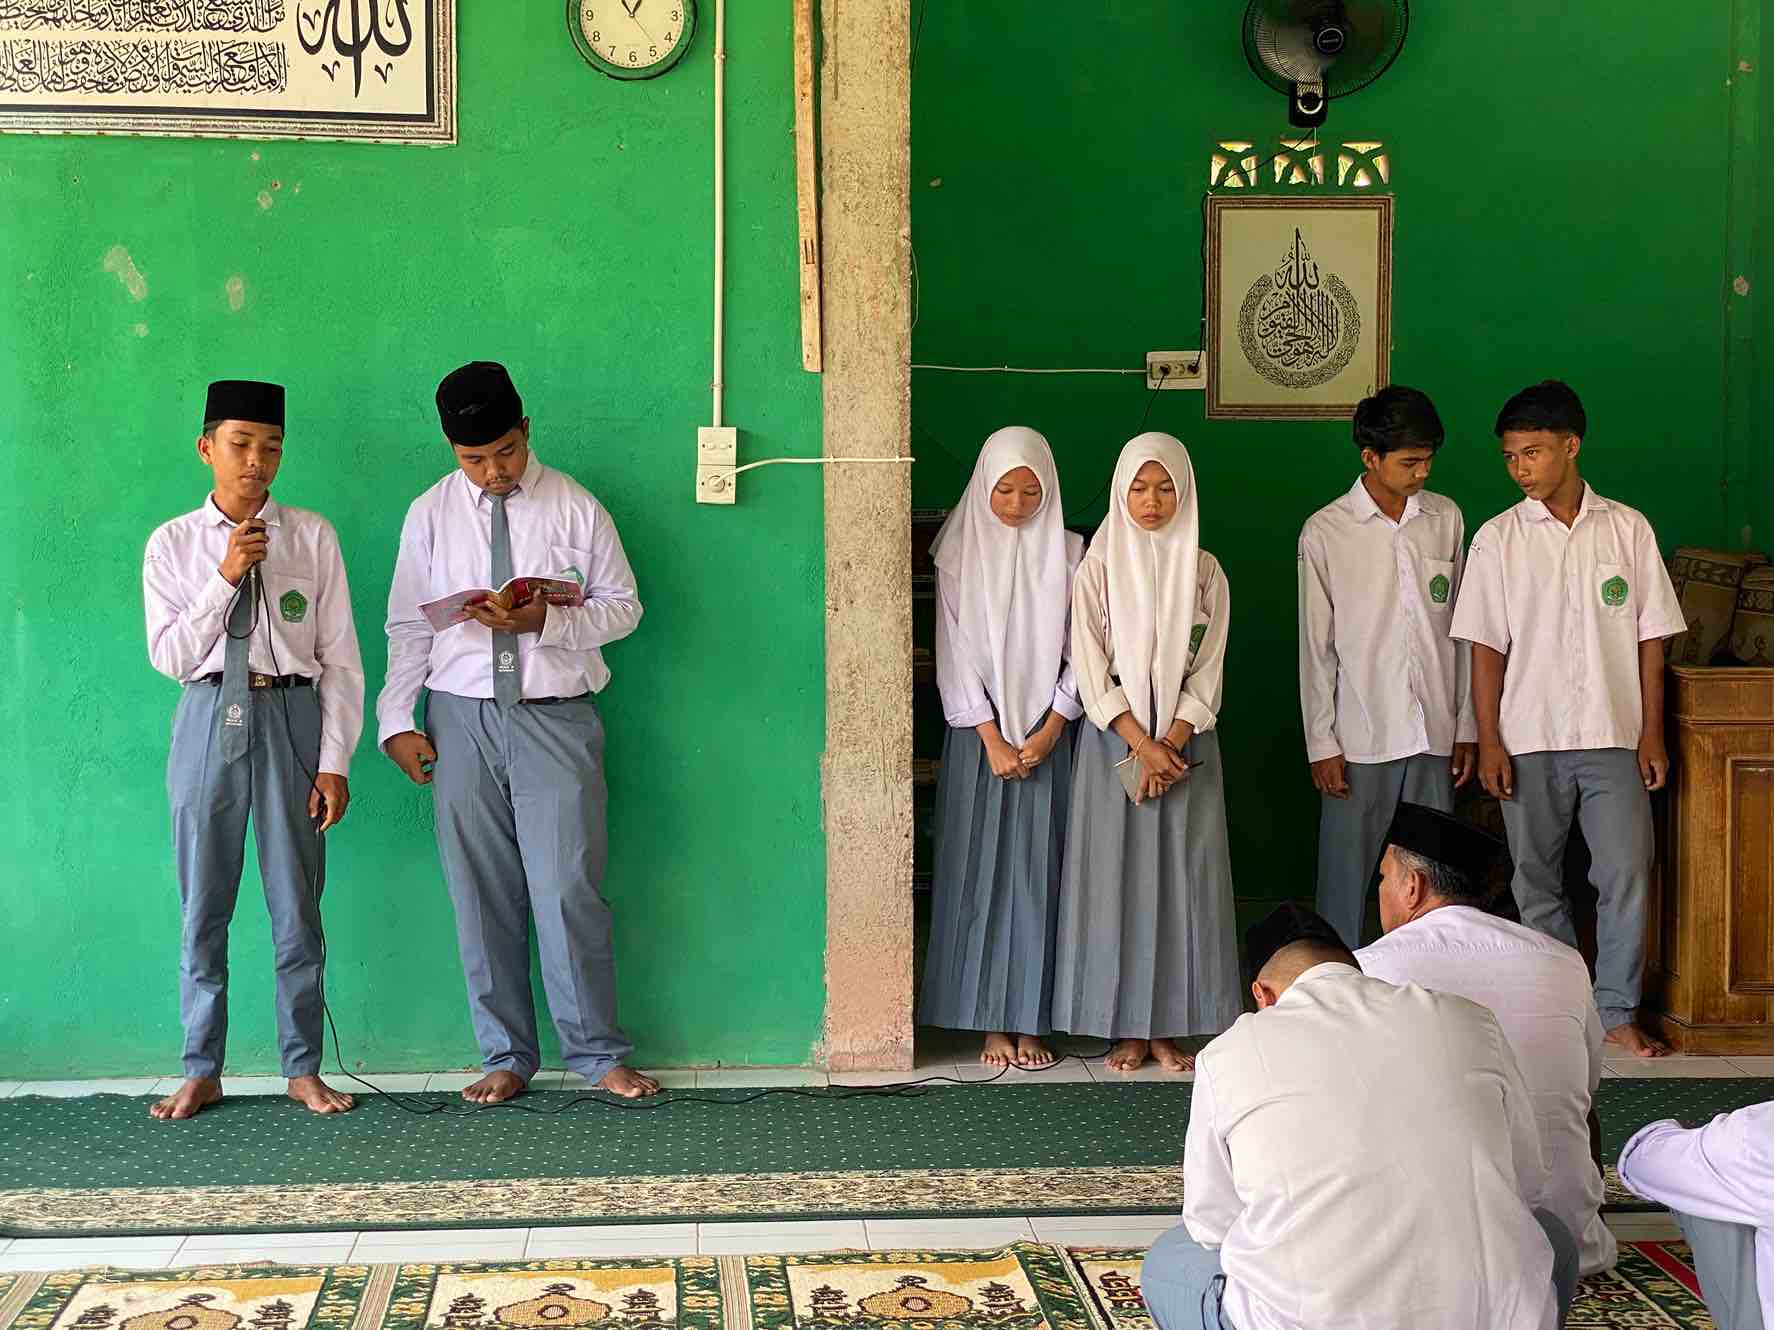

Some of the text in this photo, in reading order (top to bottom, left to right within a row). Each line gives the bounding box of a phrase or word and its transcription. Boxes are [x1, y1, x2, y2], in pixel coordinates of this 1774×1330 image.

[585, 10, 594, 21] 9
[671, 10, 679, 21] 3
[592, 31, 601, 42] 8
[664, 32, 672, 42] 4
[608, 45, 616, 56] 7
[649, 45, 657, 57] 5
[629, 51, 637, 62] 6
